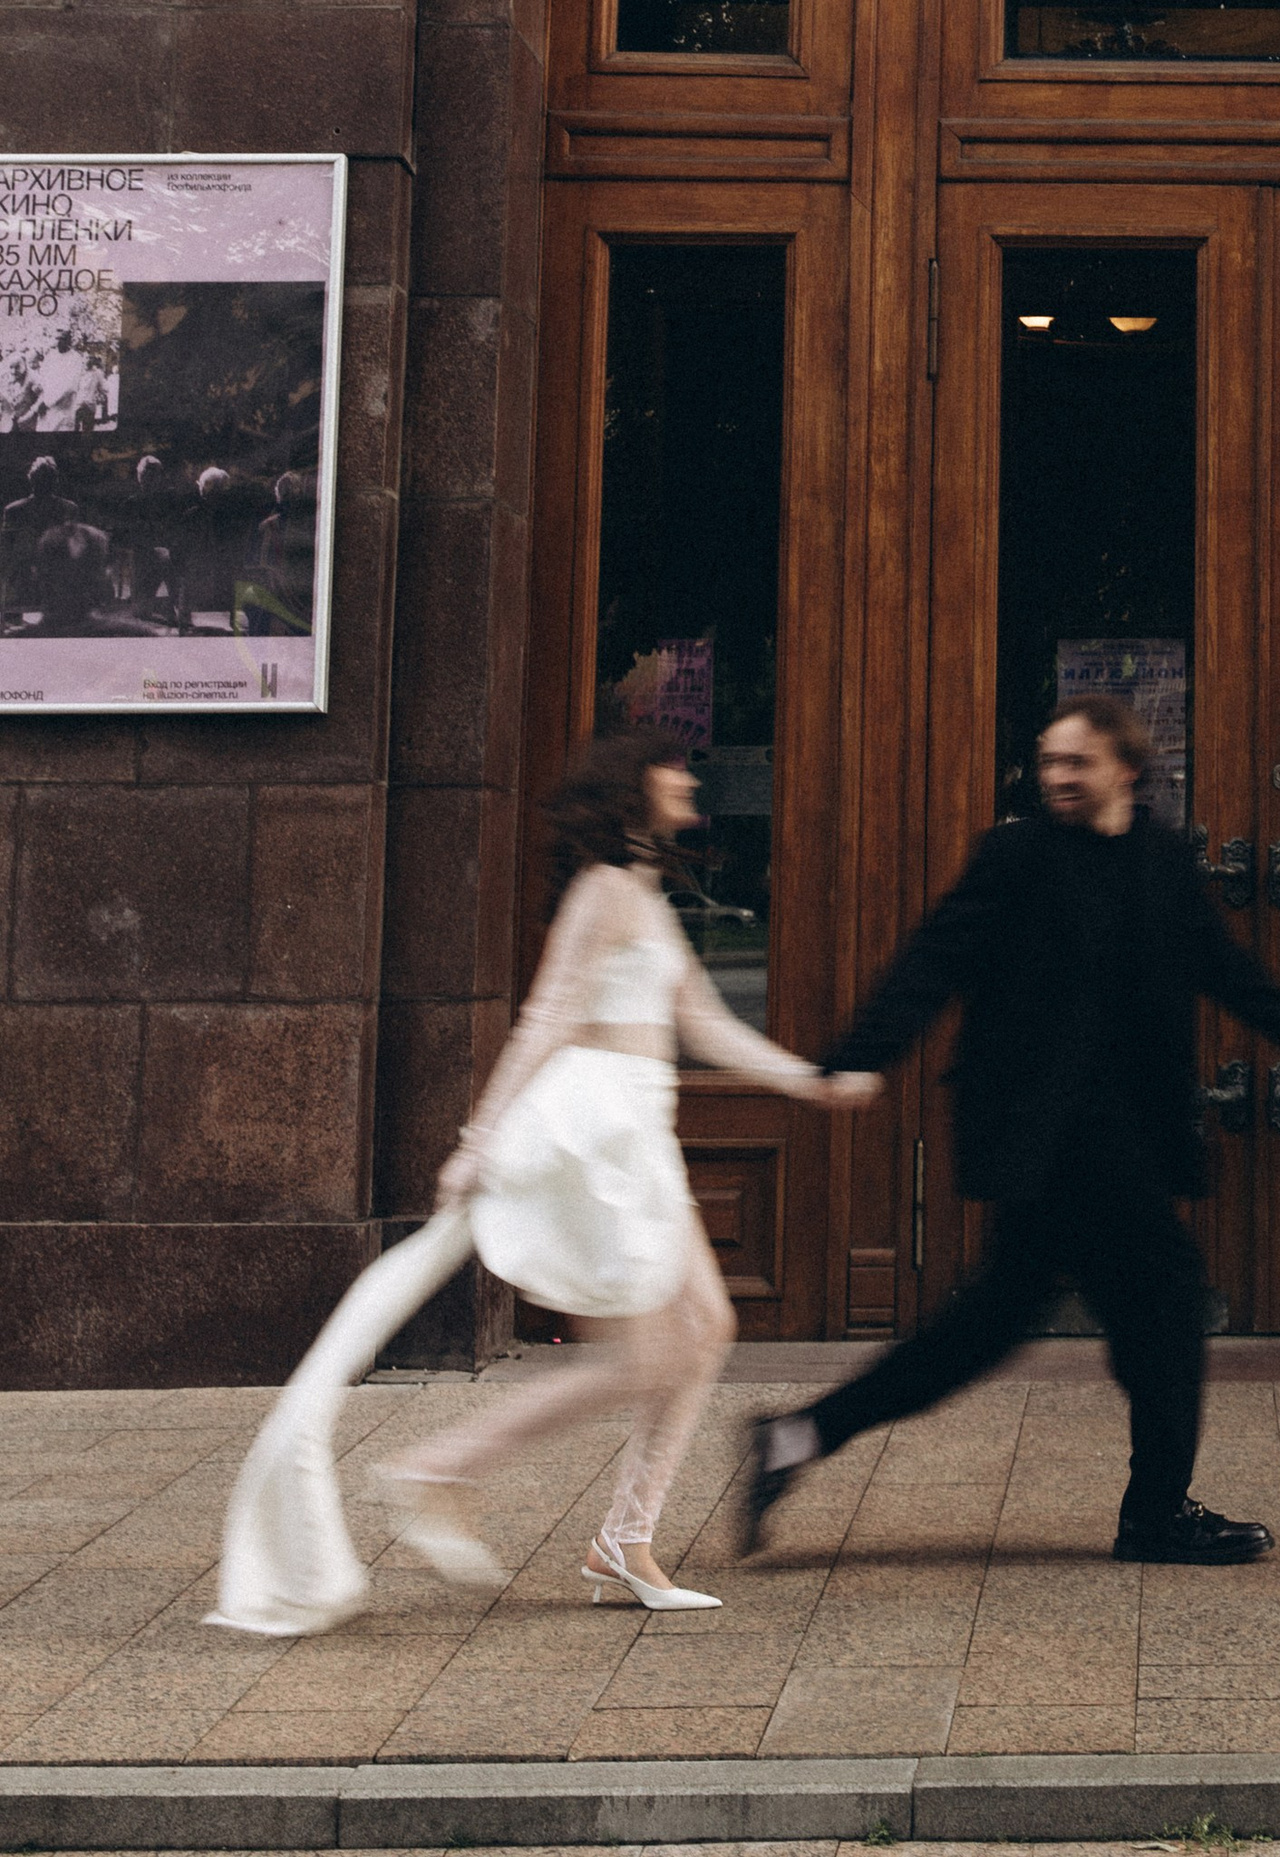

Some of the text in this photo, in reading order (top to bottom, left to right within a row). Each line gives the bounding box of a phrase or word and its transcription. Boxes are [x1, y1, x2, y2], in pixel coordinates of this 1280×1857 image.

[0, 244, 77, 266] 5 ММ
[143, 680, 248, 690] Вход по регистрации
